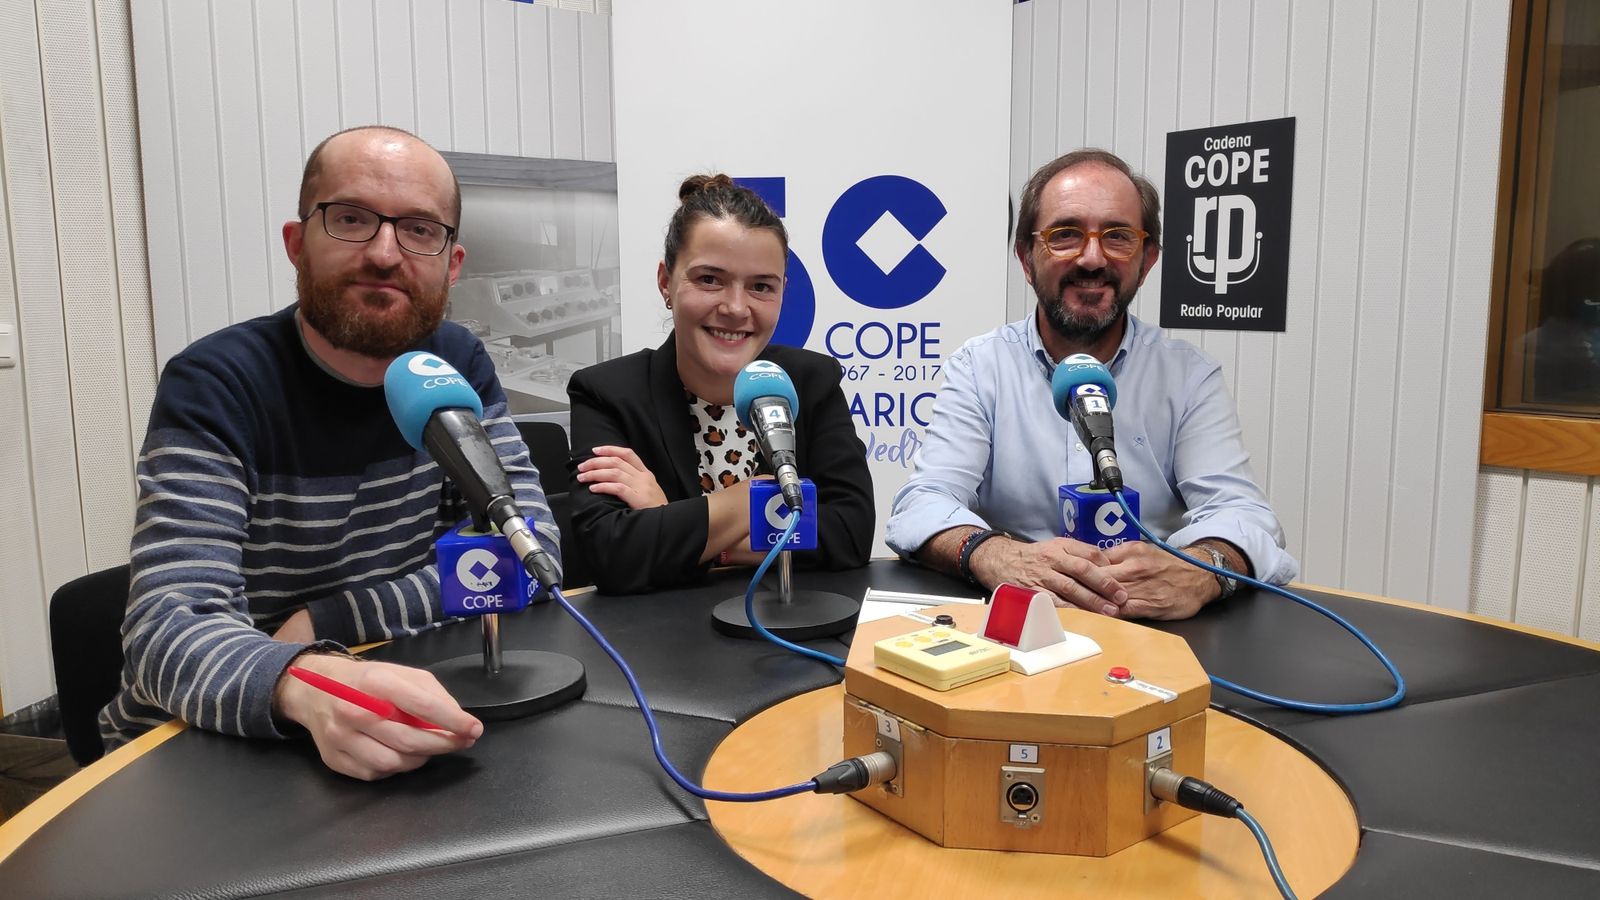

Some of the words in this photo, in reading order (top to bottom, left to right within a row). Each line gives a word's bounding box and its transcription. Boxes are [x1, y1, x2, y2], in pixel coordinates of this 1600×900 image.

[1204, 135, 1252, 151] Cadena
[1184, 148, 1270, 189] COPE
[1180, 304, 1213, 318] Radio
[1216, 304, 1263, 321] Popular
[825, 321, 941, 360] COPE
[840, 365, 870, 381] 967
[893, 365, 942, 381] 2017
[423, 377, 468, 389] COPE
[1091, 399, 1102, 408] 1
[769, 409, 781, 418] 4
[462, 594, 504, 610] COPE
[885, 720, 892, 733] 3
[1156, 737, 1163, 750] 2
[1020, 749, 1028, 760] 5
